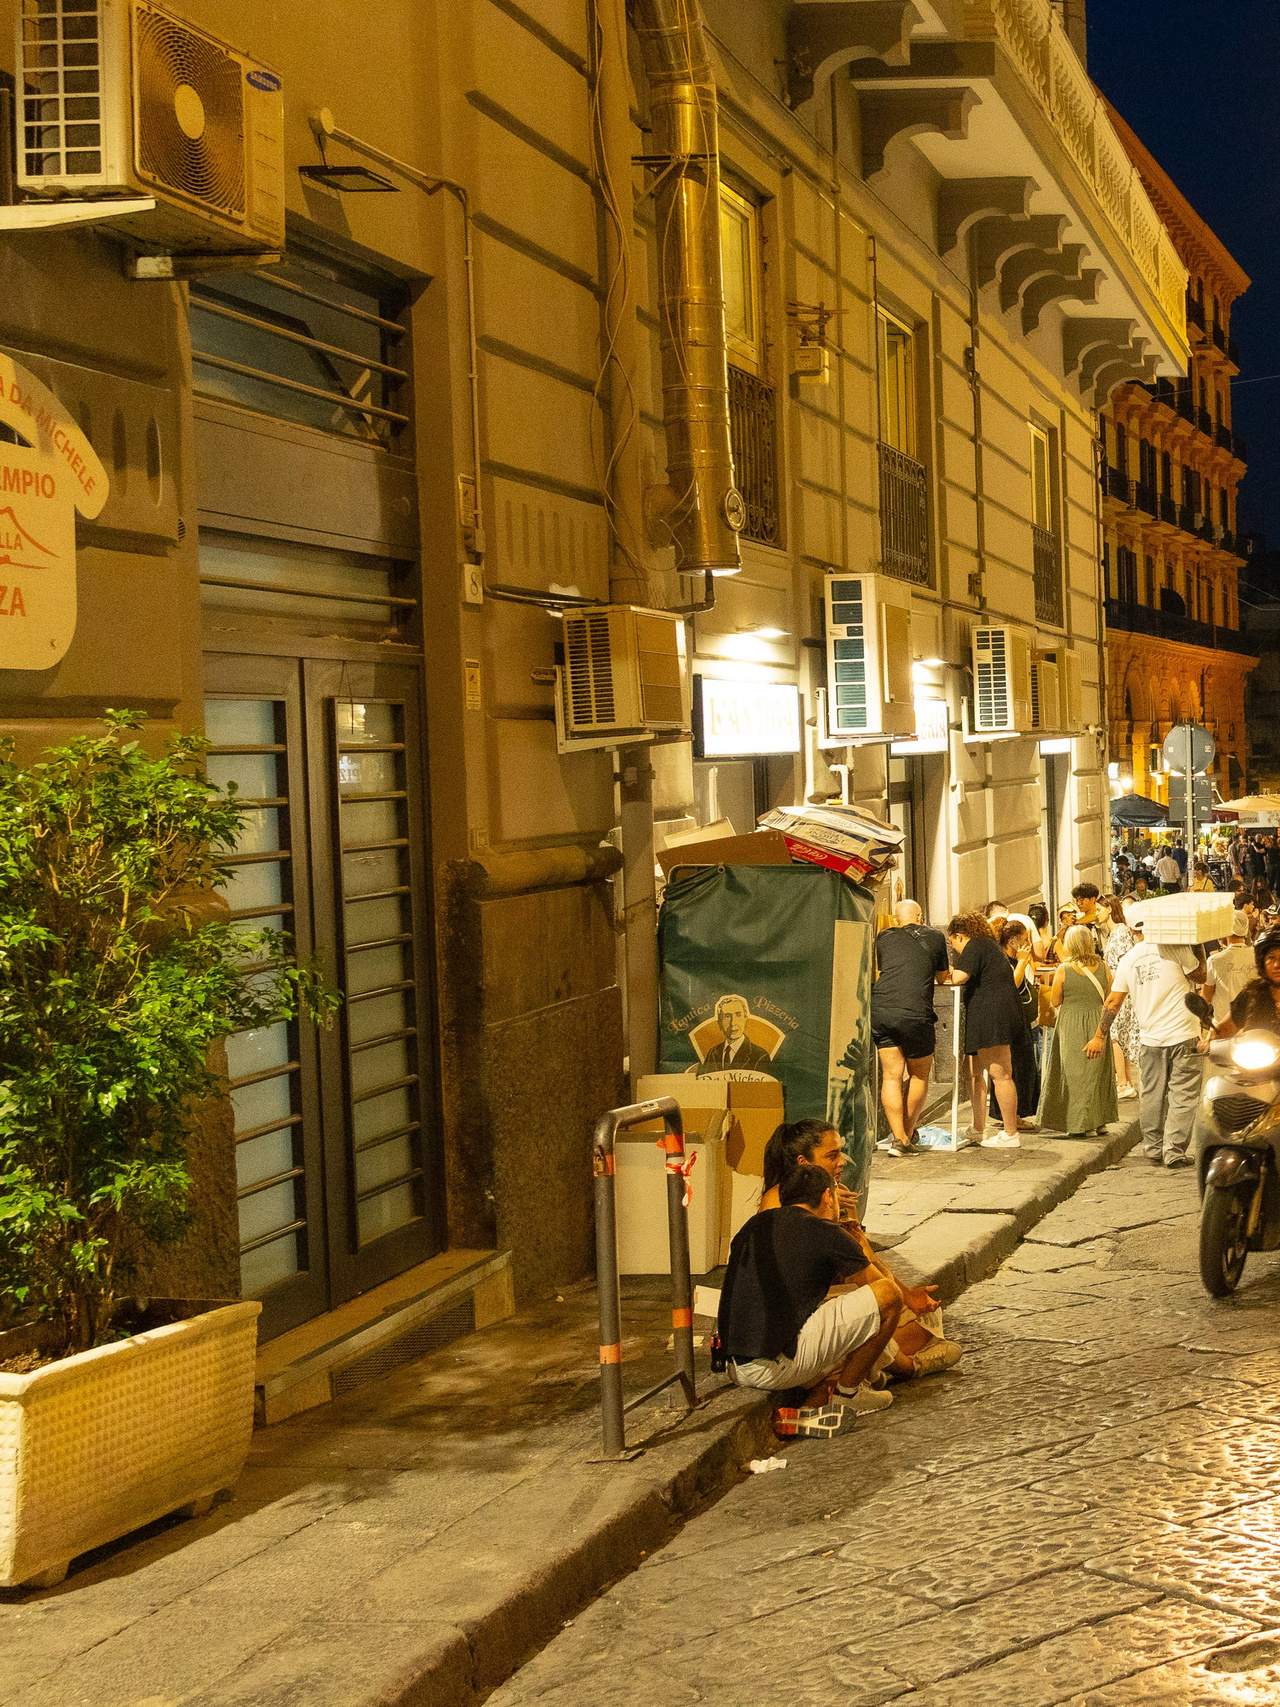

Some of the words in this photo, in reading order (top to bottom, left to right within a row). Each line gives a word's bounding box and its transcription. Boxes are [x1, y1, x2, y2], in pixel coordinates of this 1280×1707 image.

[10, 383, 33, 416] DA
[36, 406, 96, 496] MICHELE
[0, 466, 55, 499] MPIO
[470, 570, 479, 596] 8
